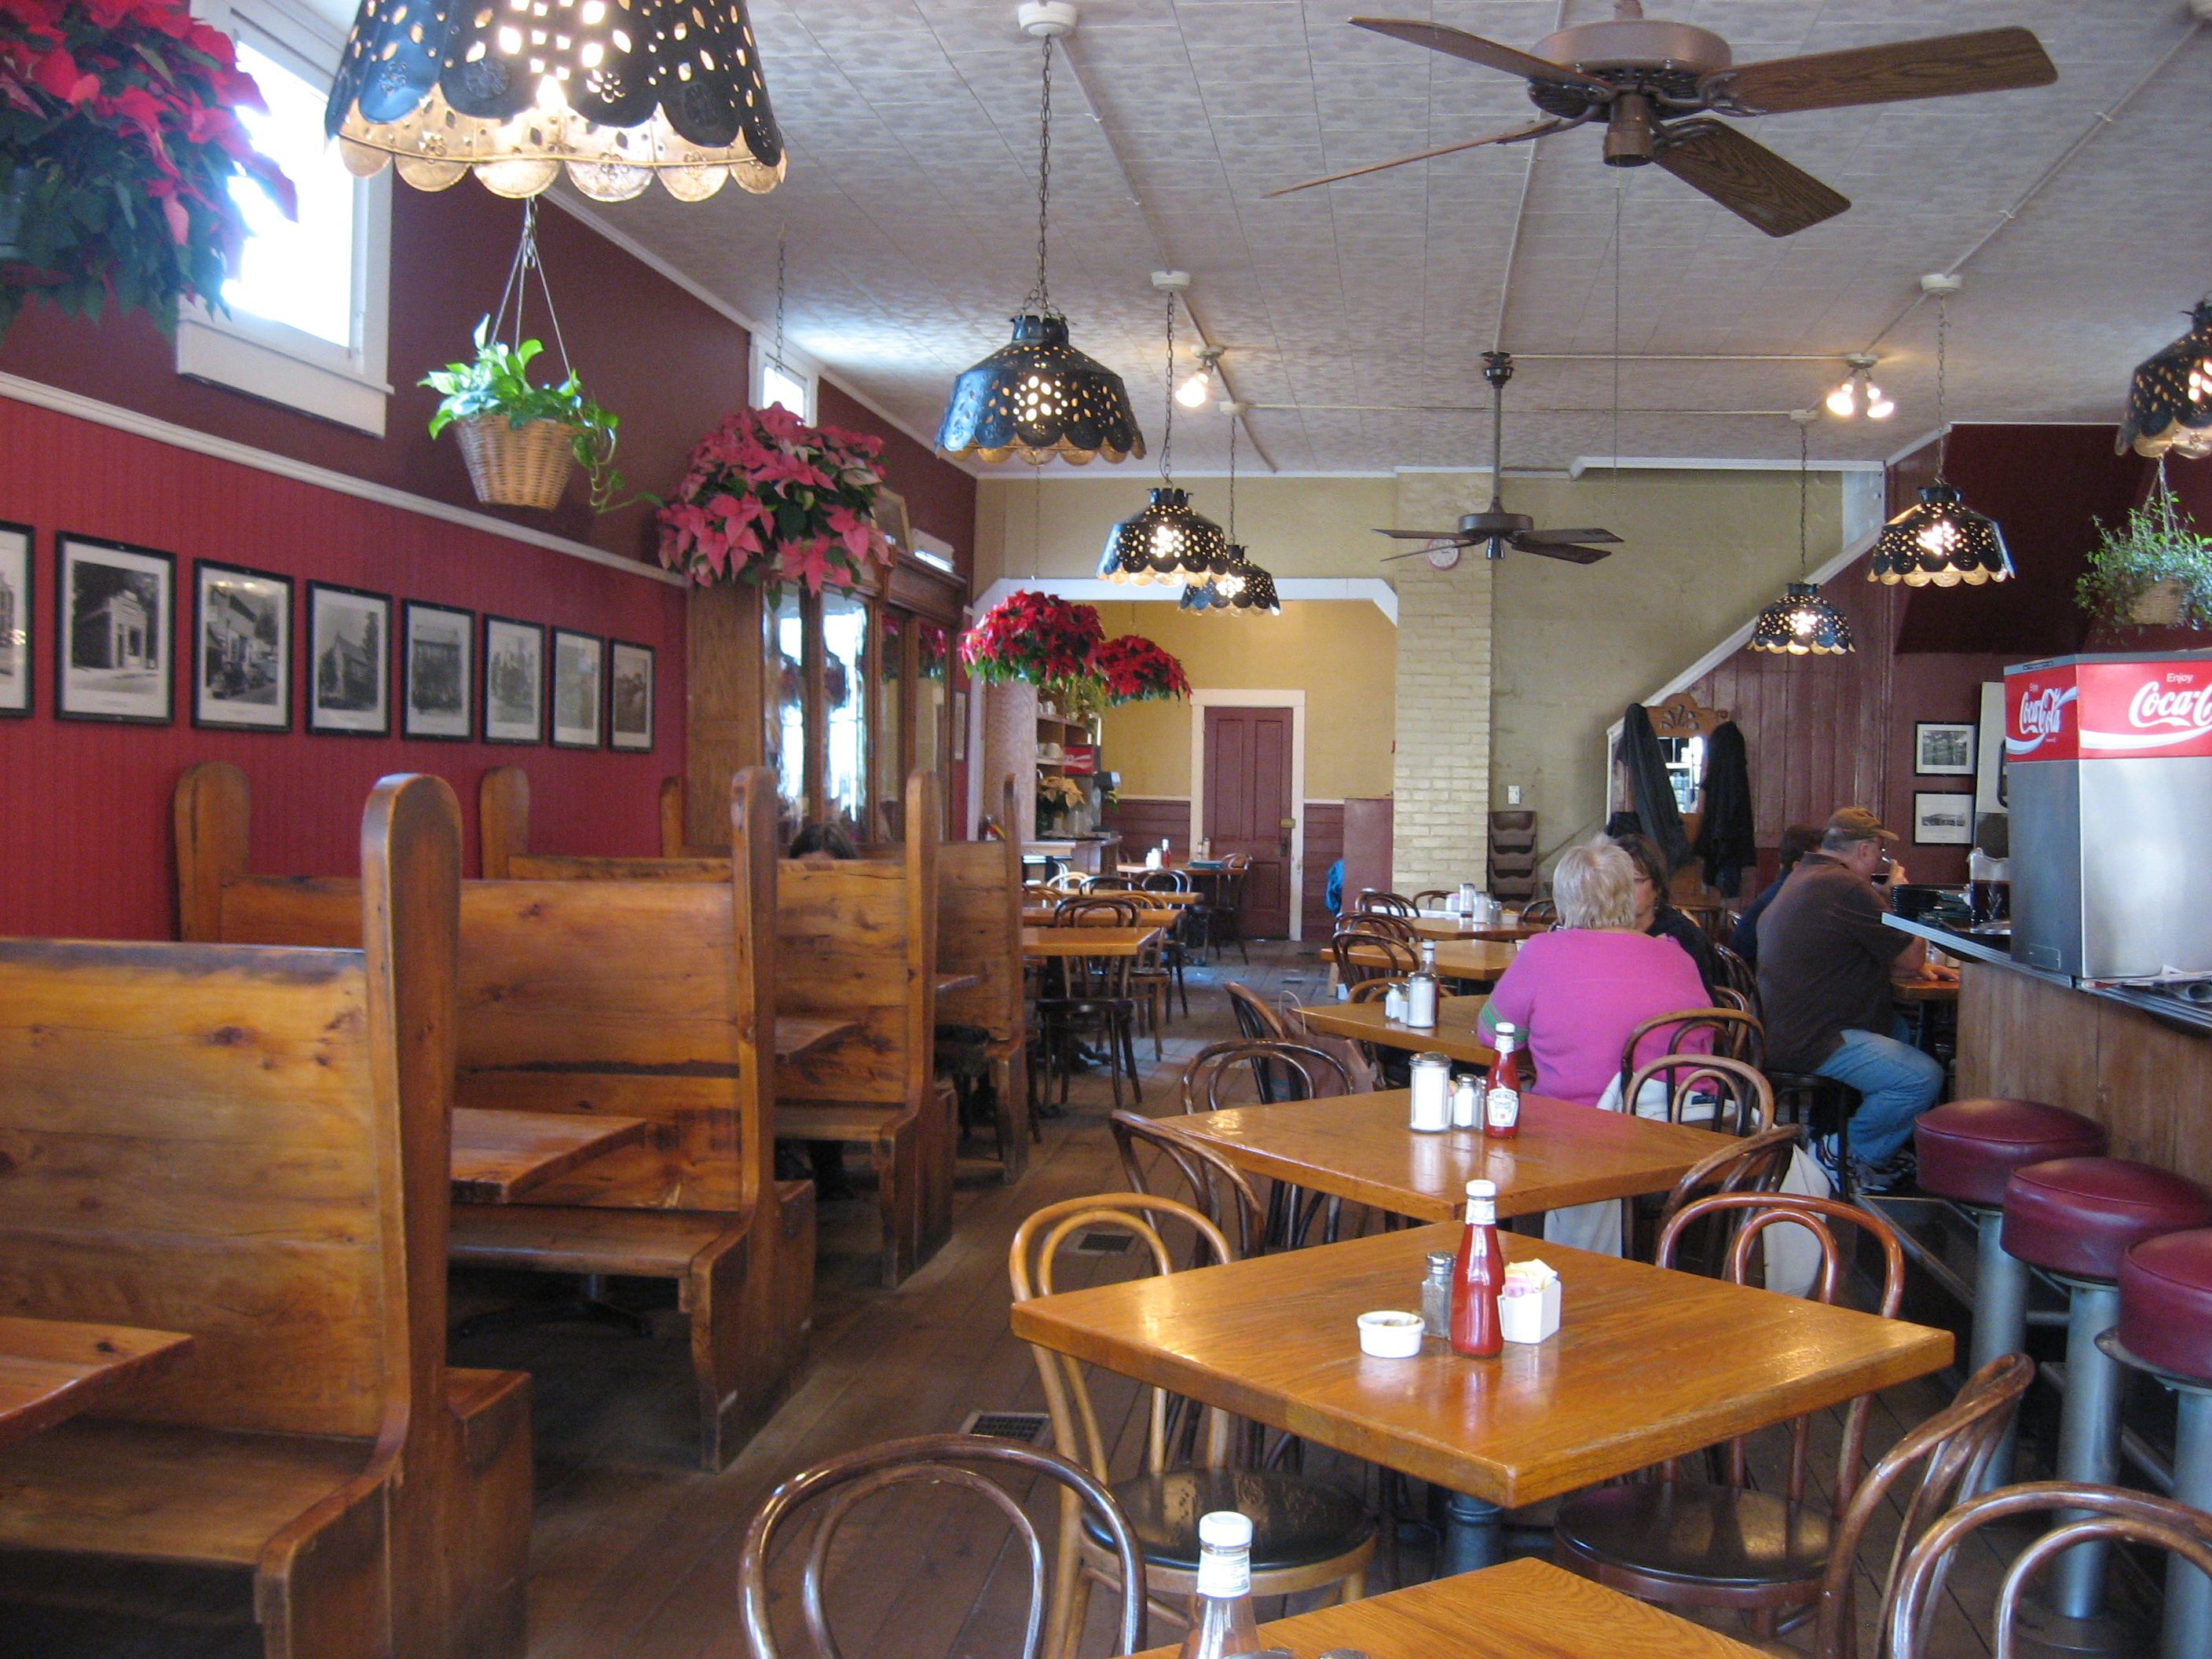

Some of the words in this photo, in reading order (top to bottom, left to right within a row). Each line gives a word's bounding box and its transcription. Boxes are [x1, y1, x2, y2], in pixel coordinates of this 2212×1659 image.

[2166, 672, 2194, 683] Enjoy
[2019, 687, 2061, 734] Coca-Cola
[2128, 681, 2212, 728] Coca-C
